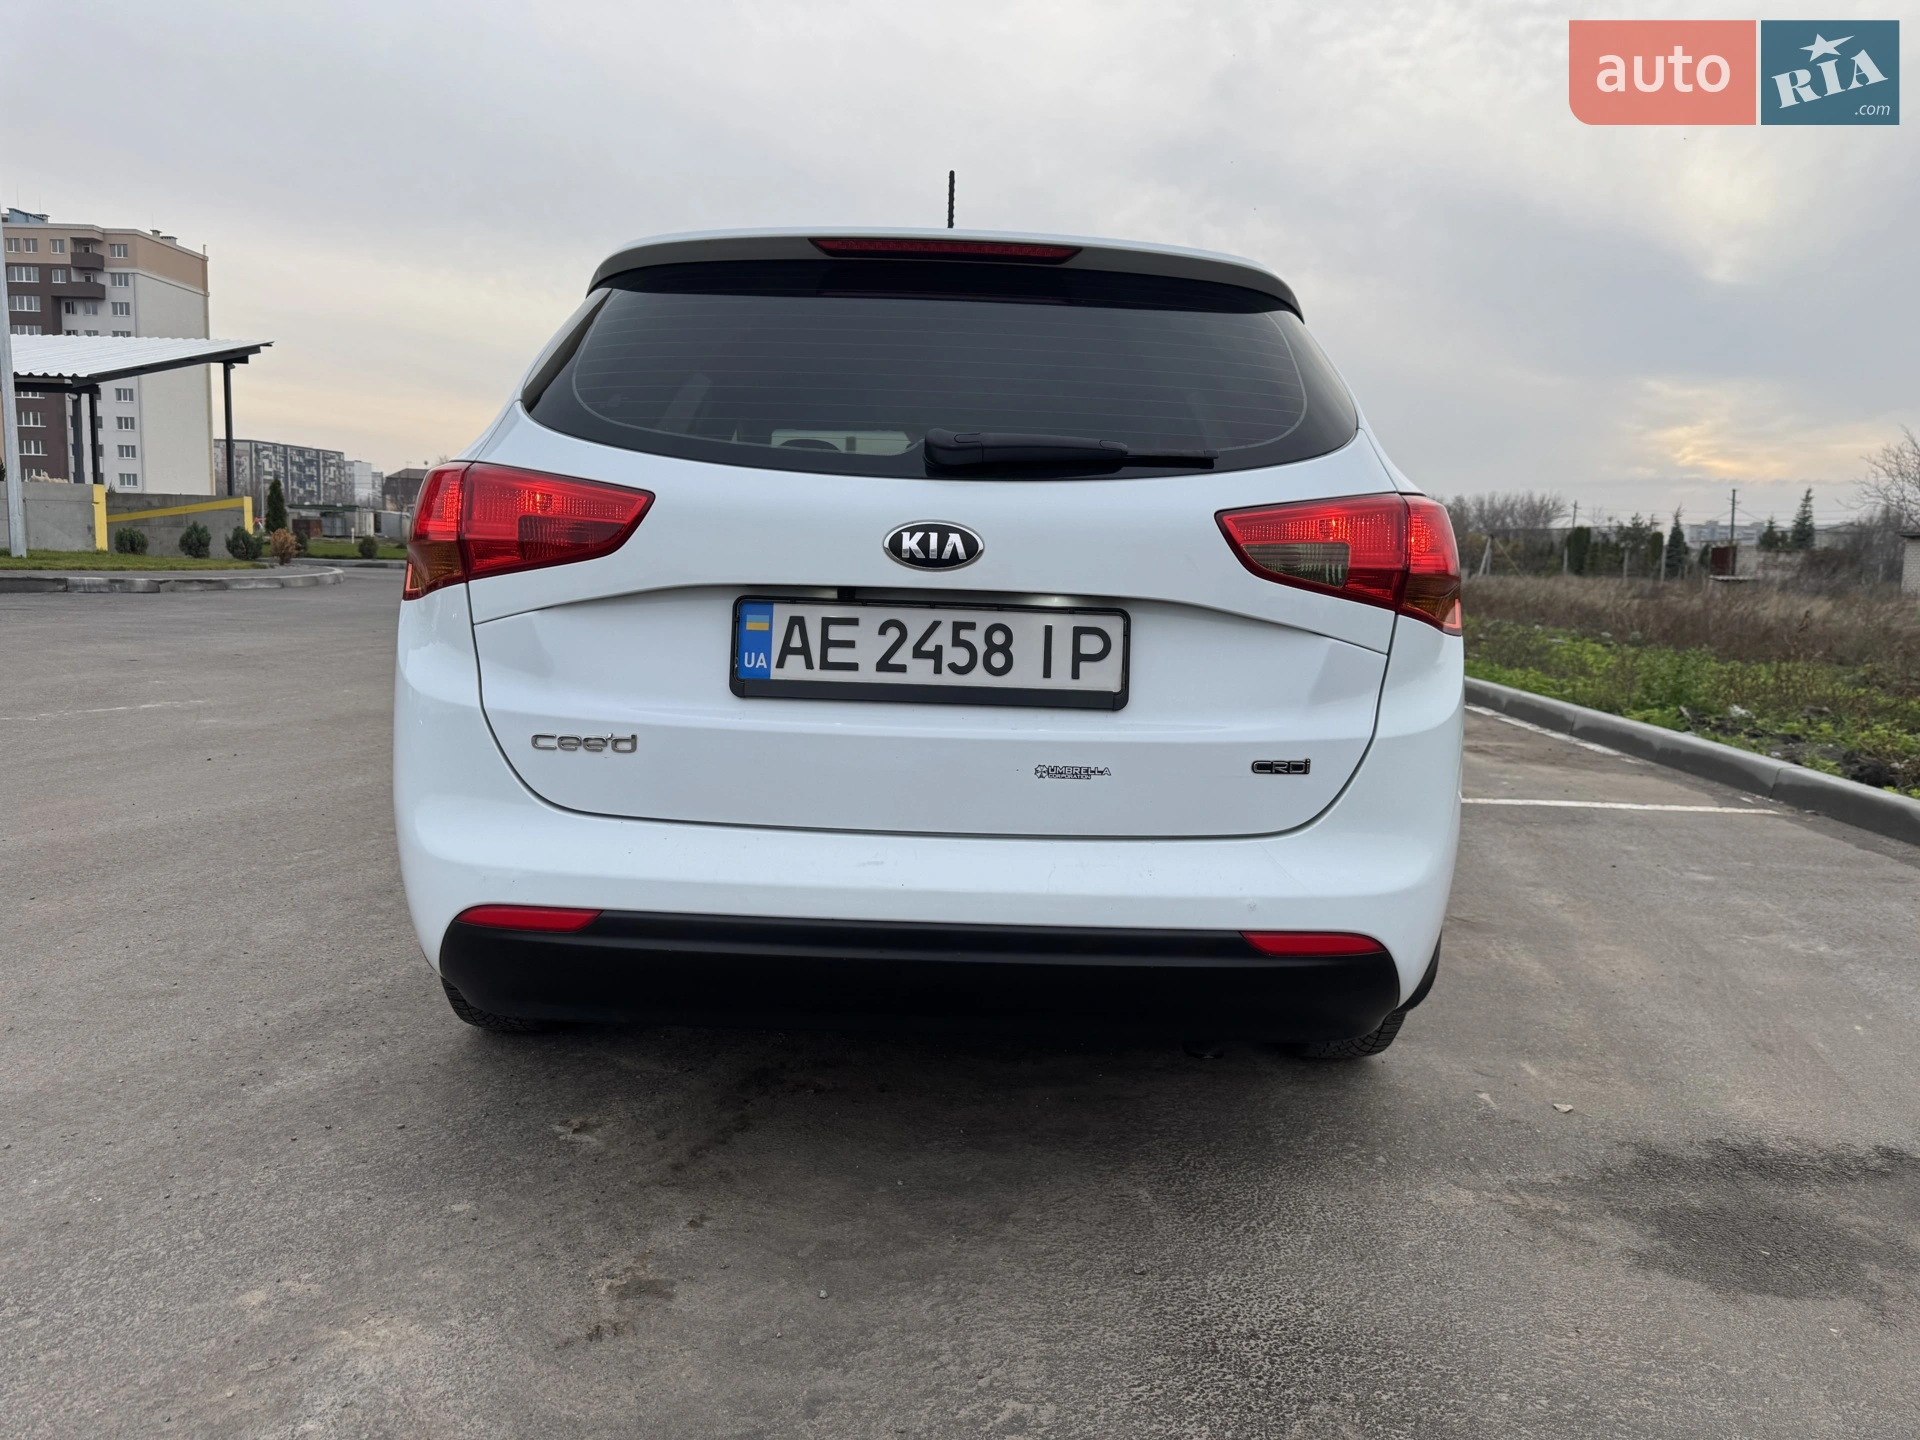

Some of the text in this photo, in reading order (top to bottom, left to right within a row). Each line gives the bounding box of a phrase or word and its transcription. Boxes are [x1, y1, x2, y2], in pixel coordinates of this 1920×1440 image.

[901, 531, 967, 560] KIA
[775, 615, 1112, 680] AE 2458 IP
[744, 651, 768, 669] UA
[1048, 765, 1111, 776] UMBRELLA
